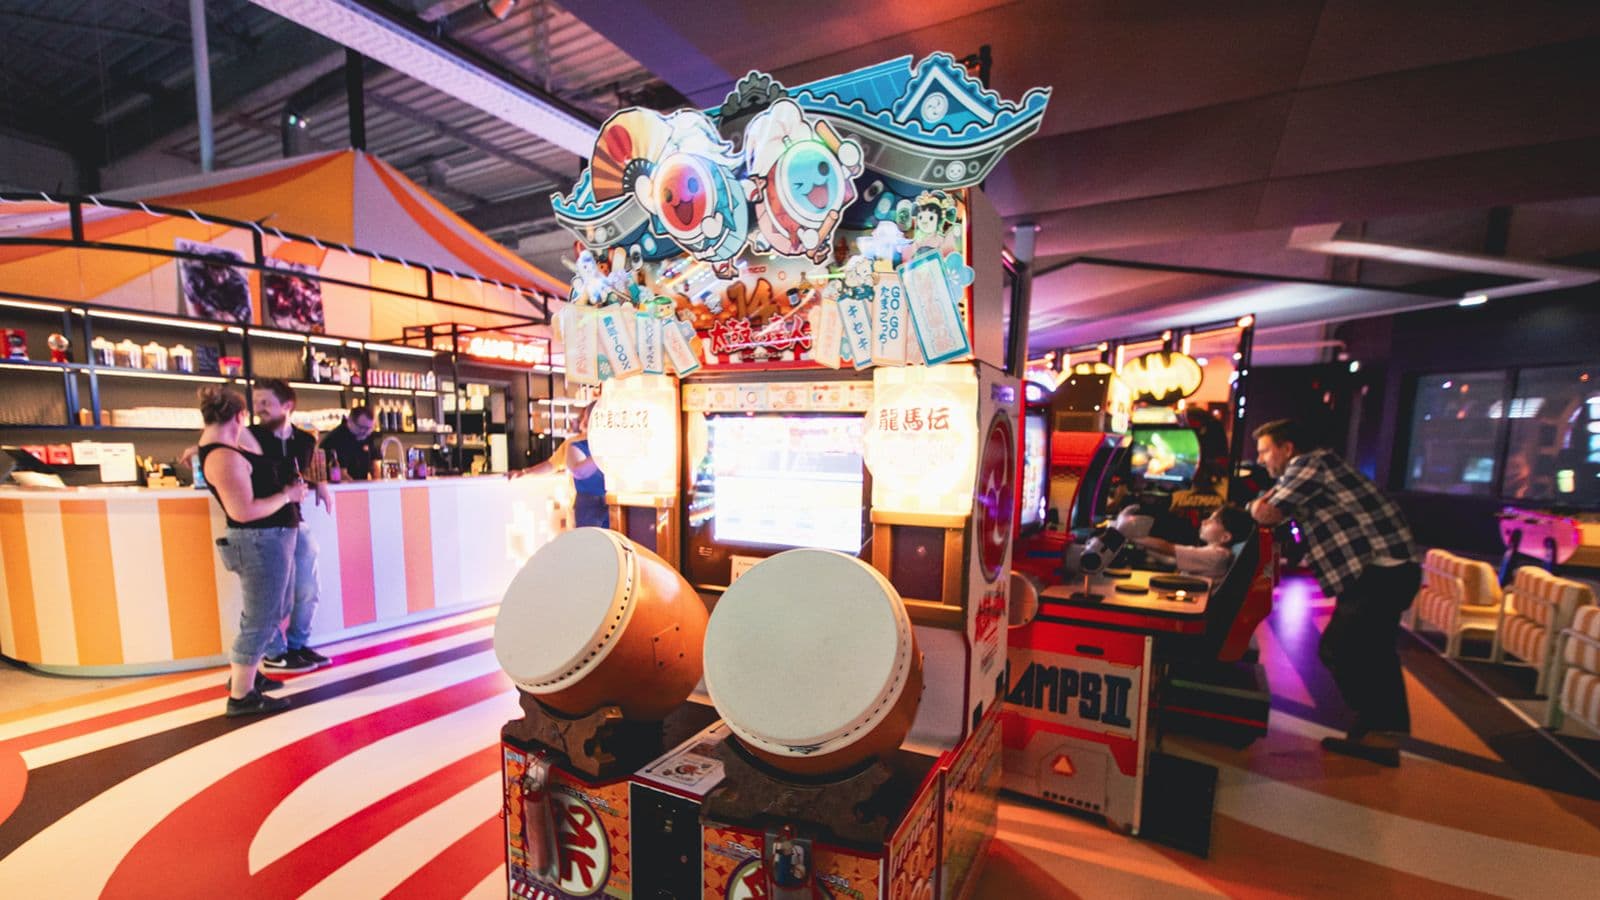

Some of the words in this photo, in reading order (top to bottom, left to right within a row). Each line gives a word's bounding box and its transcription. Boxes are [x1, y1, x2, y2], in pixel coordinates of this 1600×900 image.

[847, 304, 870, 350] キセキ
[879, 407, 950, 431] 龍馬伝
